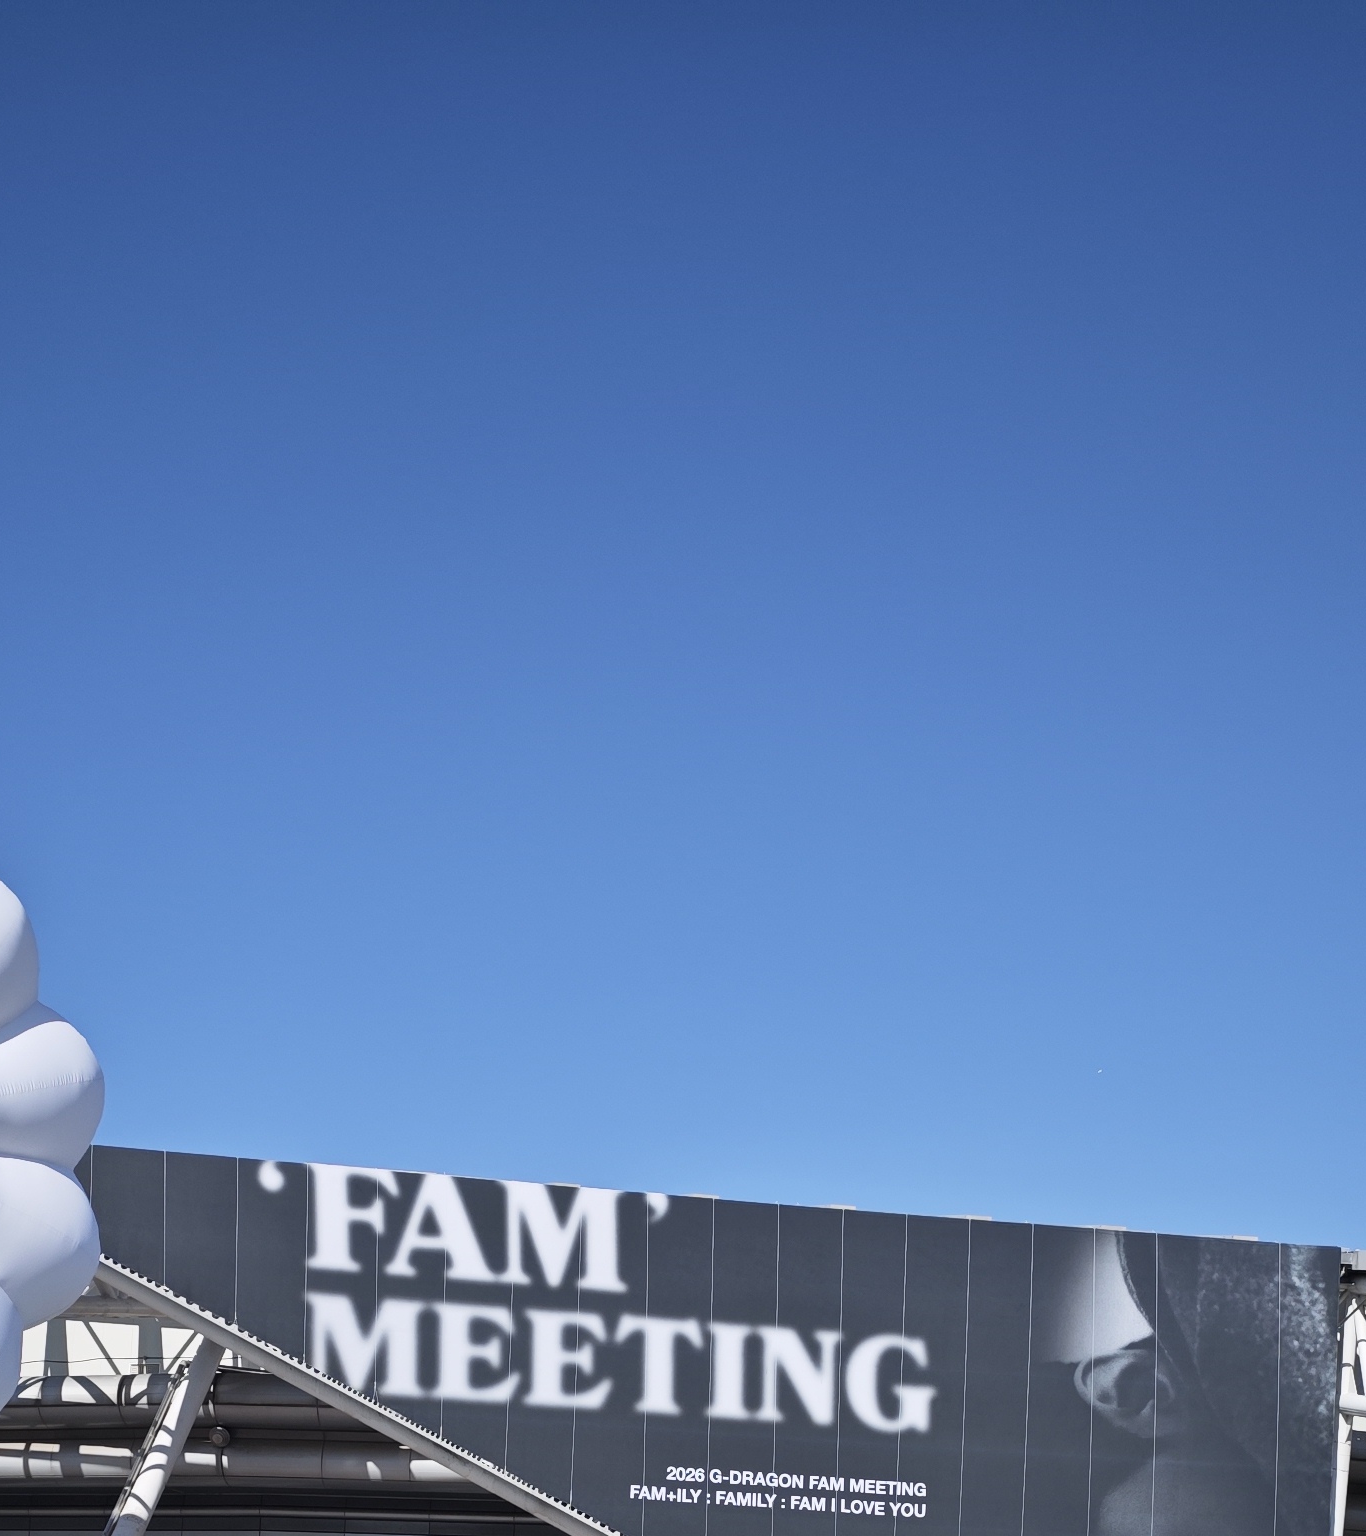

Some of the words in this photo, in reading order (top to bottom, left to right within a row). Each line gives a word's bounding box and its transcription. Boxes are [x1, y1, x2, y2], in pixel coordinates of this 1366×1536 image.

[305, 1291, 937, 1434] MEETING
[665, 1466, 705, 1483] 2026
[709, 1468, 804, 1489] G-DRAGON
[809, 1476, 845, 1492] FAM
[849, 1478, 927, 1497] MEETING
[629, 1484, 702, 1504] FAM+ILY
[715, 1490, 777, 1508] FAMILY
[790, 1495, 826, 1512] FAM
[841, 1498, 885, 1516] LOVE
[889, 1501, 927, 1518] YOU
